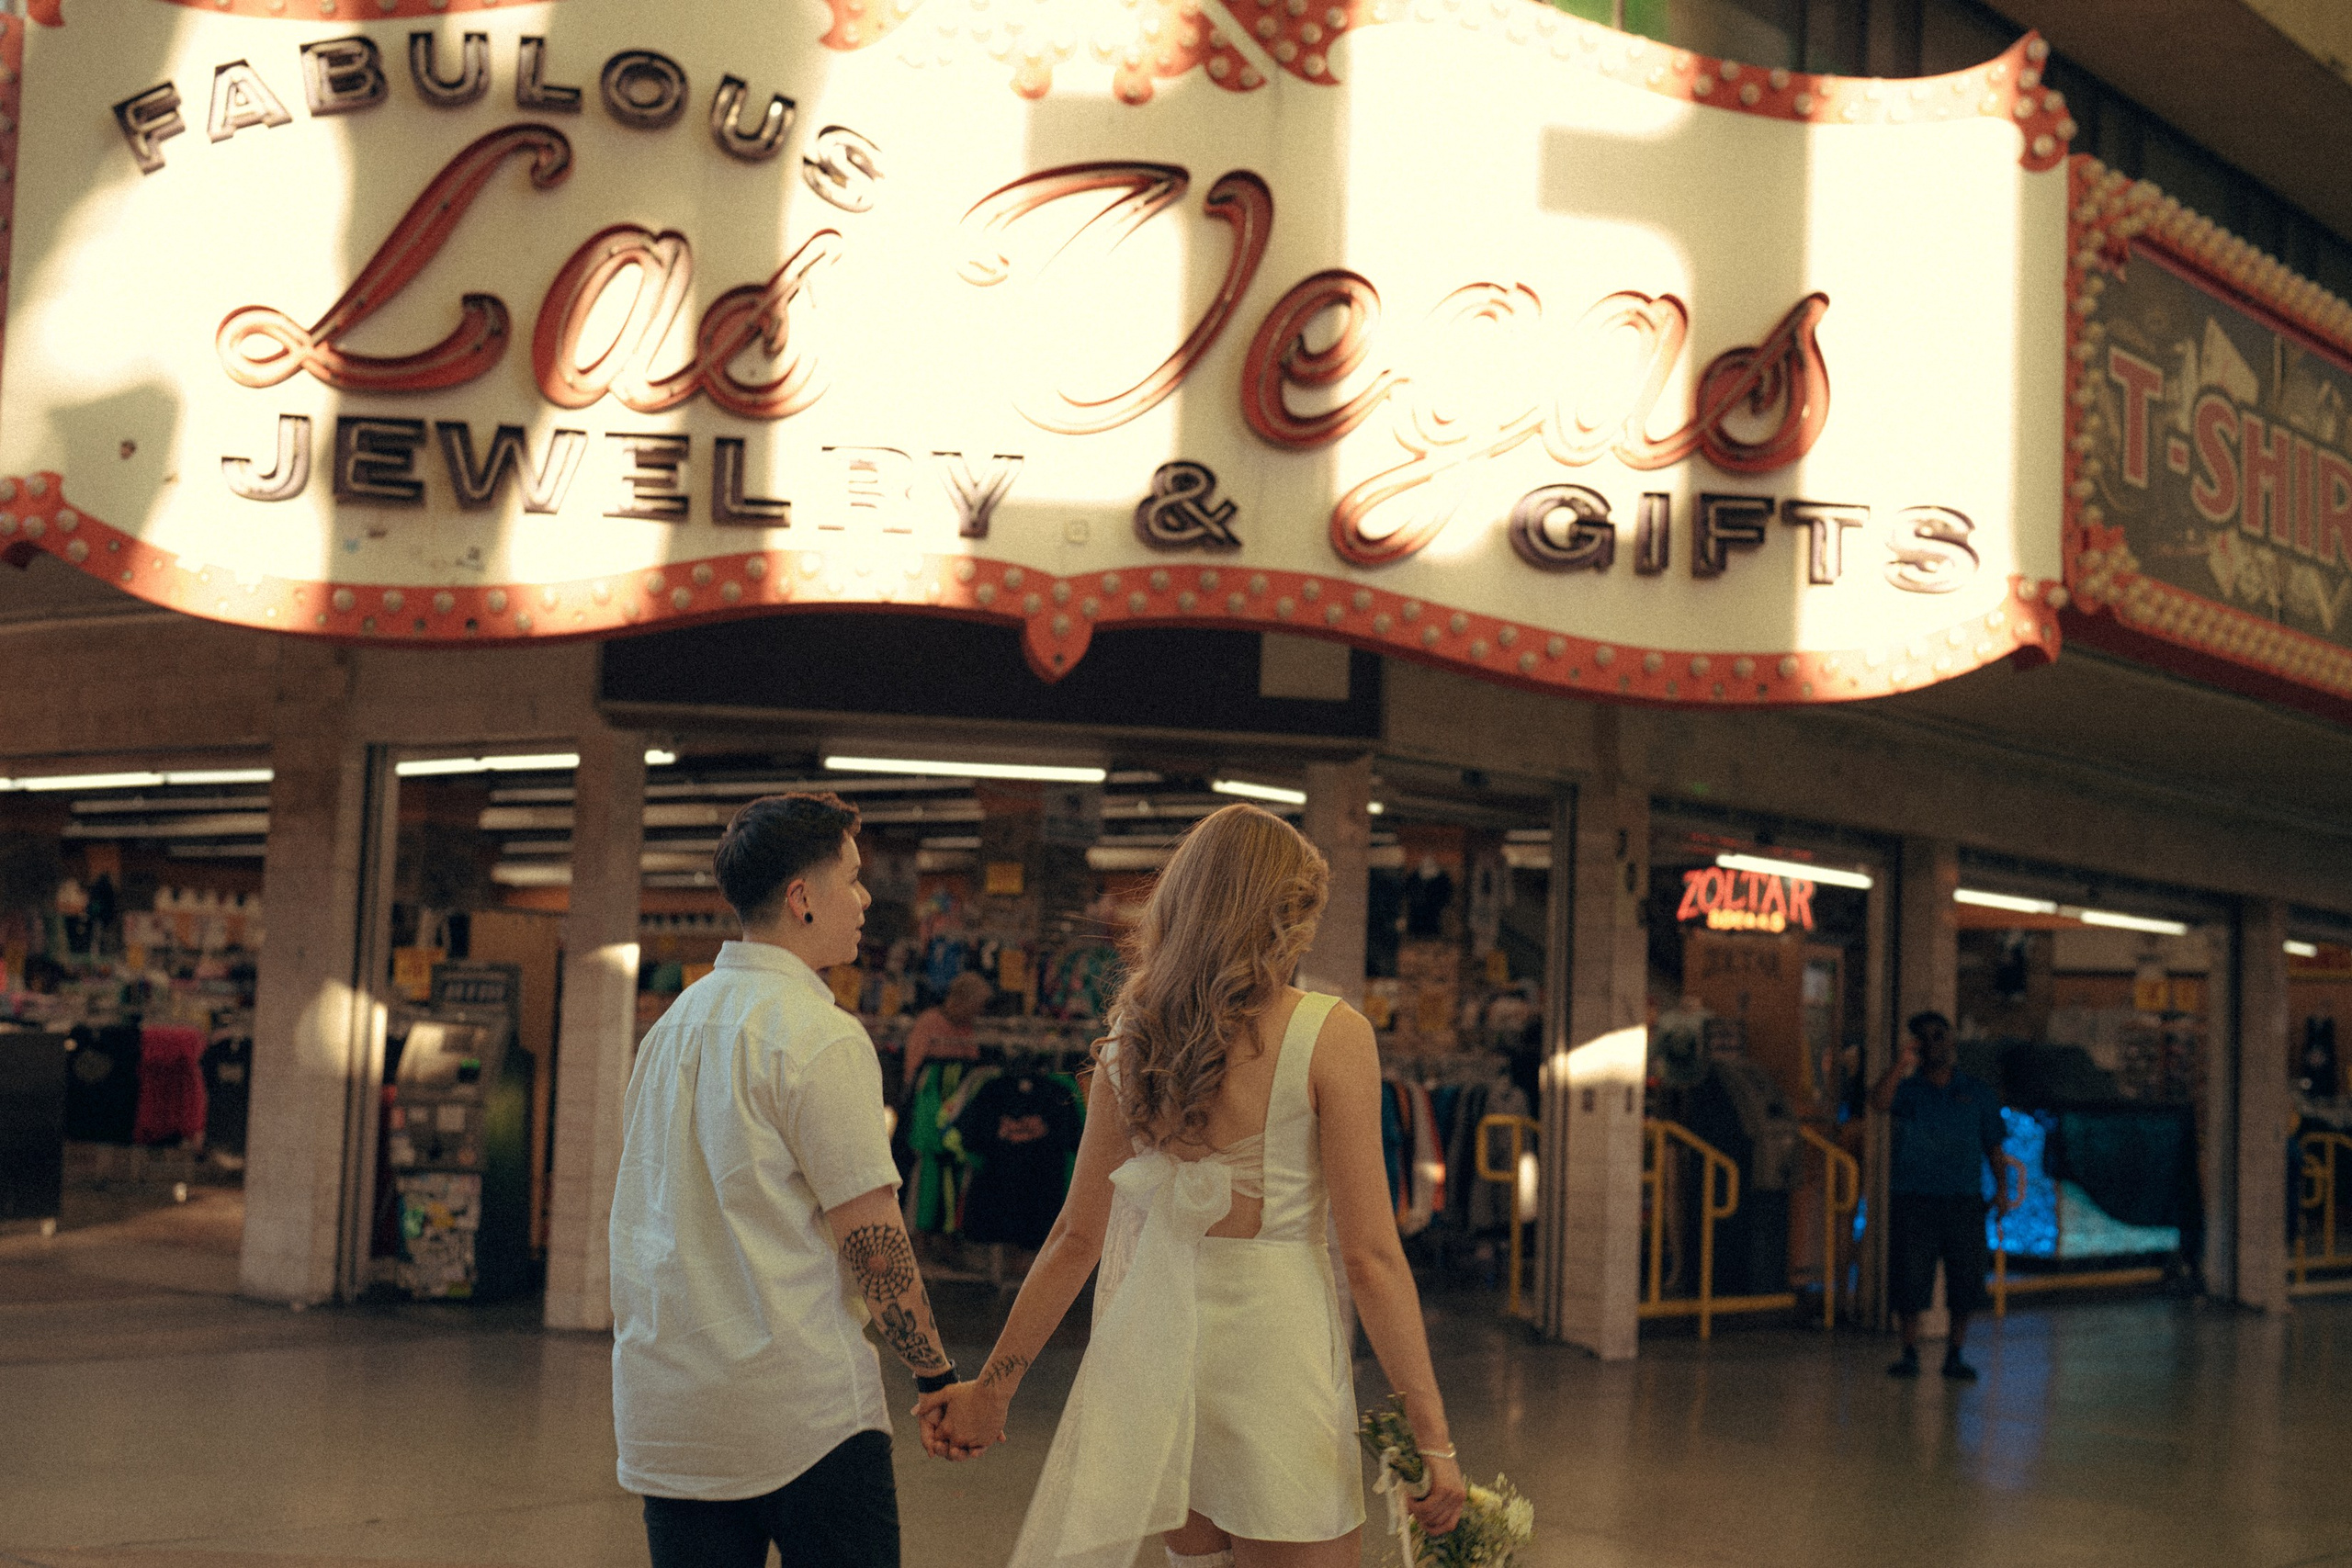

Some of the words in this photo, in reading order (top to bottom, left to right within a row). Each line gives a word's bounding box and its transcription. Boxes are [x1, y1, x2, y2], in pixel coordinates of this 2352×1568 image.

[112, 31, 886, 214] FABULOUS
[215, 122, 844, 421] Las
[954, 159, 1831, 568] Vegas
[220, 413, 1024, 540] JEWELRY
[1134, 460, 1243, 552] &
[1509, 483, 1981, 594] GIFTS
[1676, 865, 1815, 931] ZOLTAR
